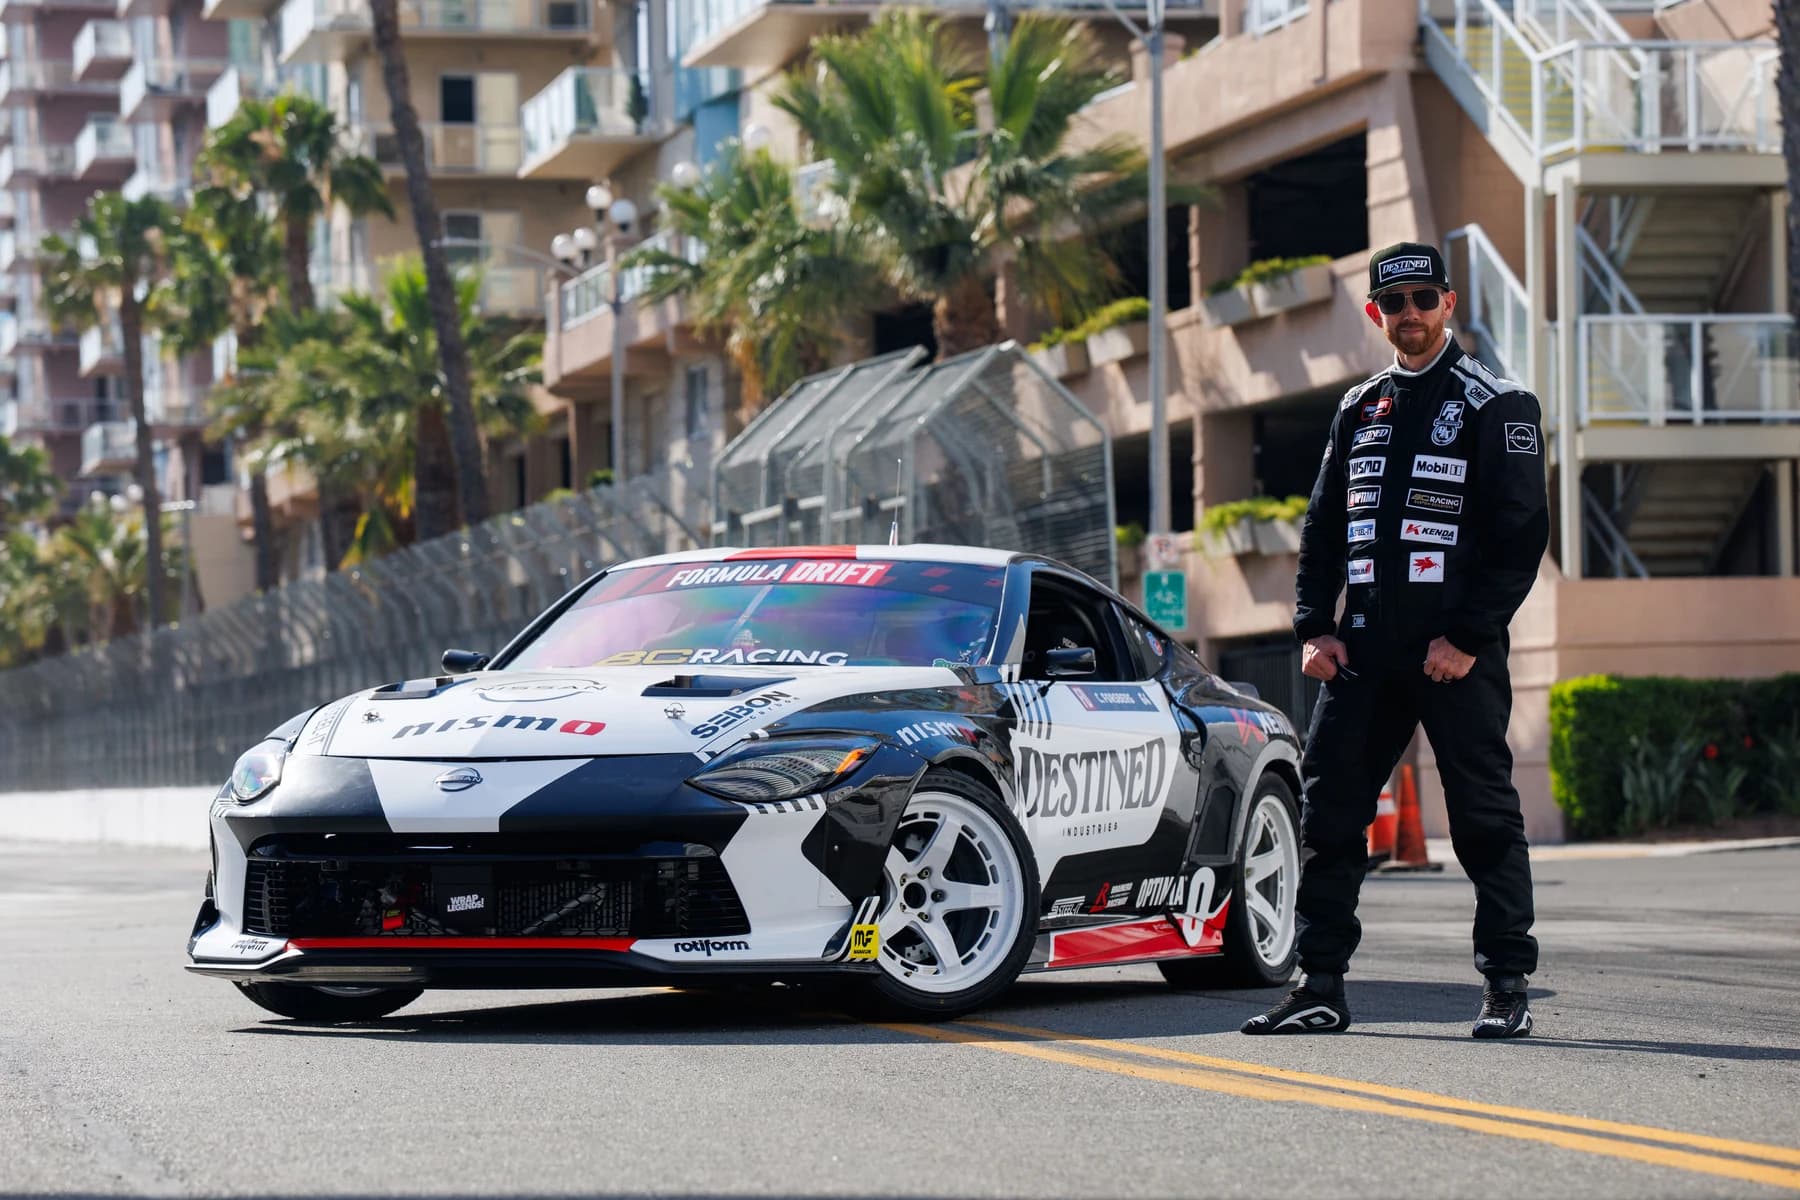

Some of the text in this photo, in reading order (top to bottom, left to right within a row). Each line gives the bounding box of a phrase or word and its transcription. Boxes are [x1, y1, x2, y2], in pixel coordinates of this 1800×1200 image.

[1382, 260, 1428, 274] DESTINED
[1470, 387, 1489, 401] OMP
[1509, 434, 1535, 442] NISSAN
[1351, 460, 1382, 476] NISMO
[1415, 460, 1449, 475] Mobil
[1429, 495, 1460, 507] RACING
[1421, 527, 1455, 538] KENDA
[666, 561, 885, 588] FORMULA DRIFT
[472, 684, 607, 692] NISSAN
[690, 690, 792, 739] SEBON
[391, 714, 606, 739] nismo
[1018, 737, 1166, 818] DESTINED
[1062, 822, 1118, 837] INDUSTRIES
[446, 898, 485, 912] LEGENDS!
[450, 894, 479, 905] WRAP
[673, 939, 751, 957] rotiform
